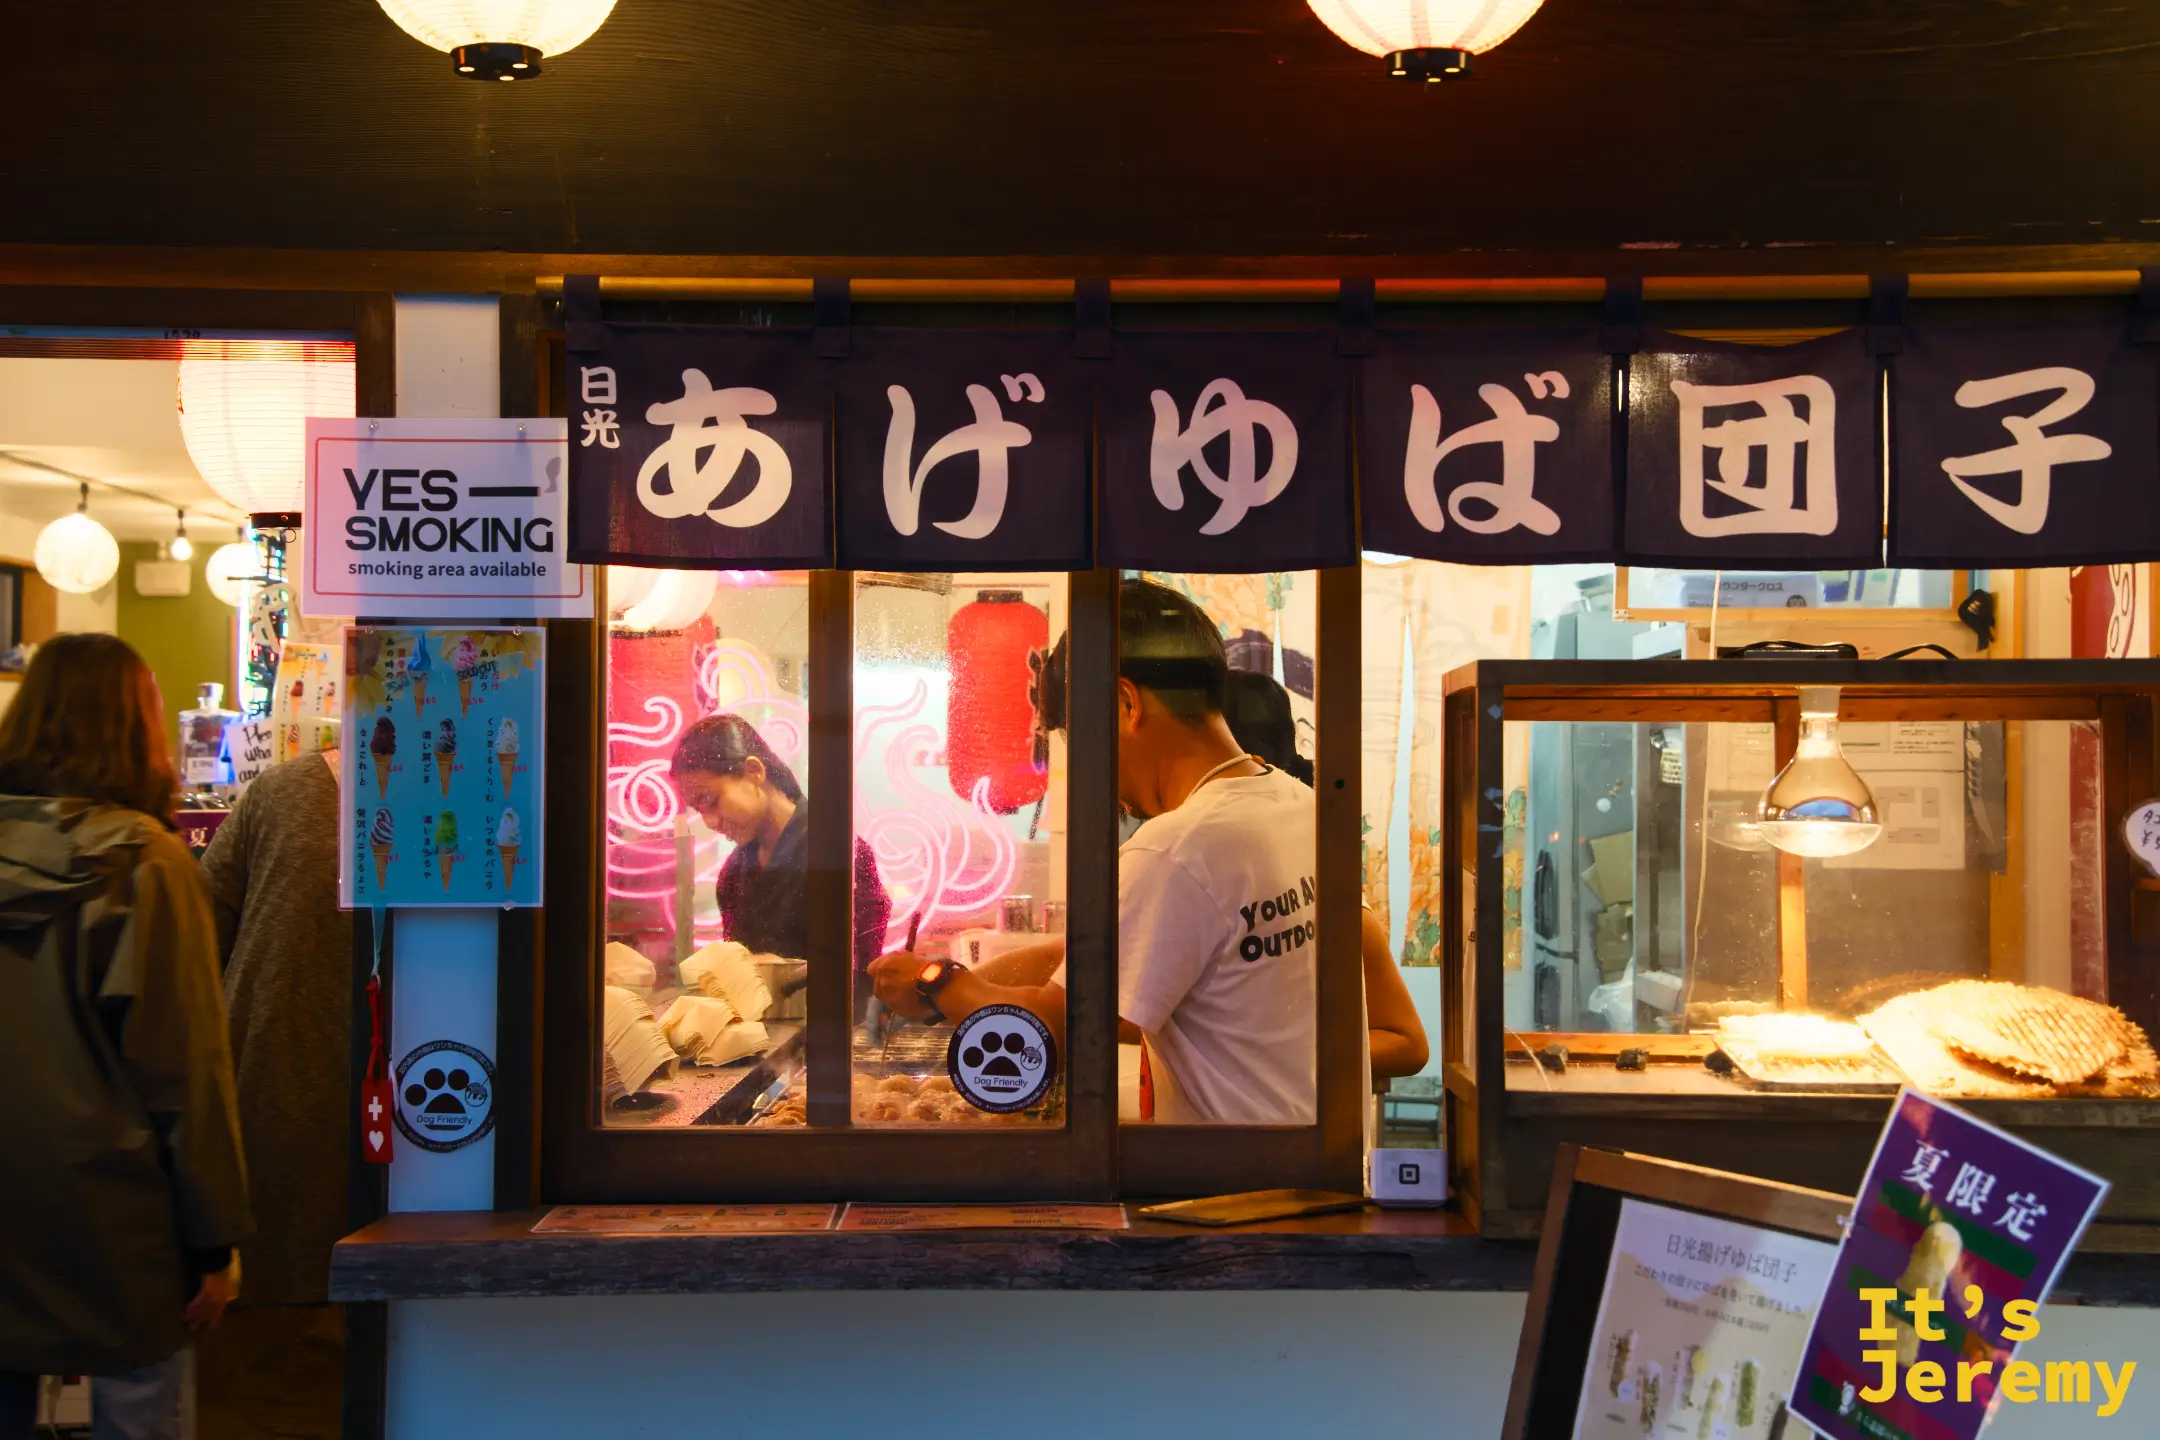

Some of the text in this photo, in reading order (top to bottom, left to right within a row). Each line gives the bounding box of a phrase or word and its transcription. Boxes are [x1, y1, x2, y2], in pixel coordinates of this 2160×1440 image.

[580, 366, 620, 449] 日光
[637, 367, 2112, 539] あげゆば団子
[343, 468, 458, 511] YES
[345, 516, 553, 552] SMOKING
[348, 560, 547, 580] smoking area available
[1719, 582, 1784, 592] ウンタークロス
[457, 661, 498, 683] SOLD OUT
[189, 827, 209, 847] 夏
[1240, 888, 1300, 933] YOUR
[974, 1077, 1028, 1088] Dog Friendly
[416, 1115, 473, 1125] Dog Friendly
[1900, 1139, 2048, 1242] 夏限定
[1666, 1233, 1797, 1283] 日光揚げゆば団子
